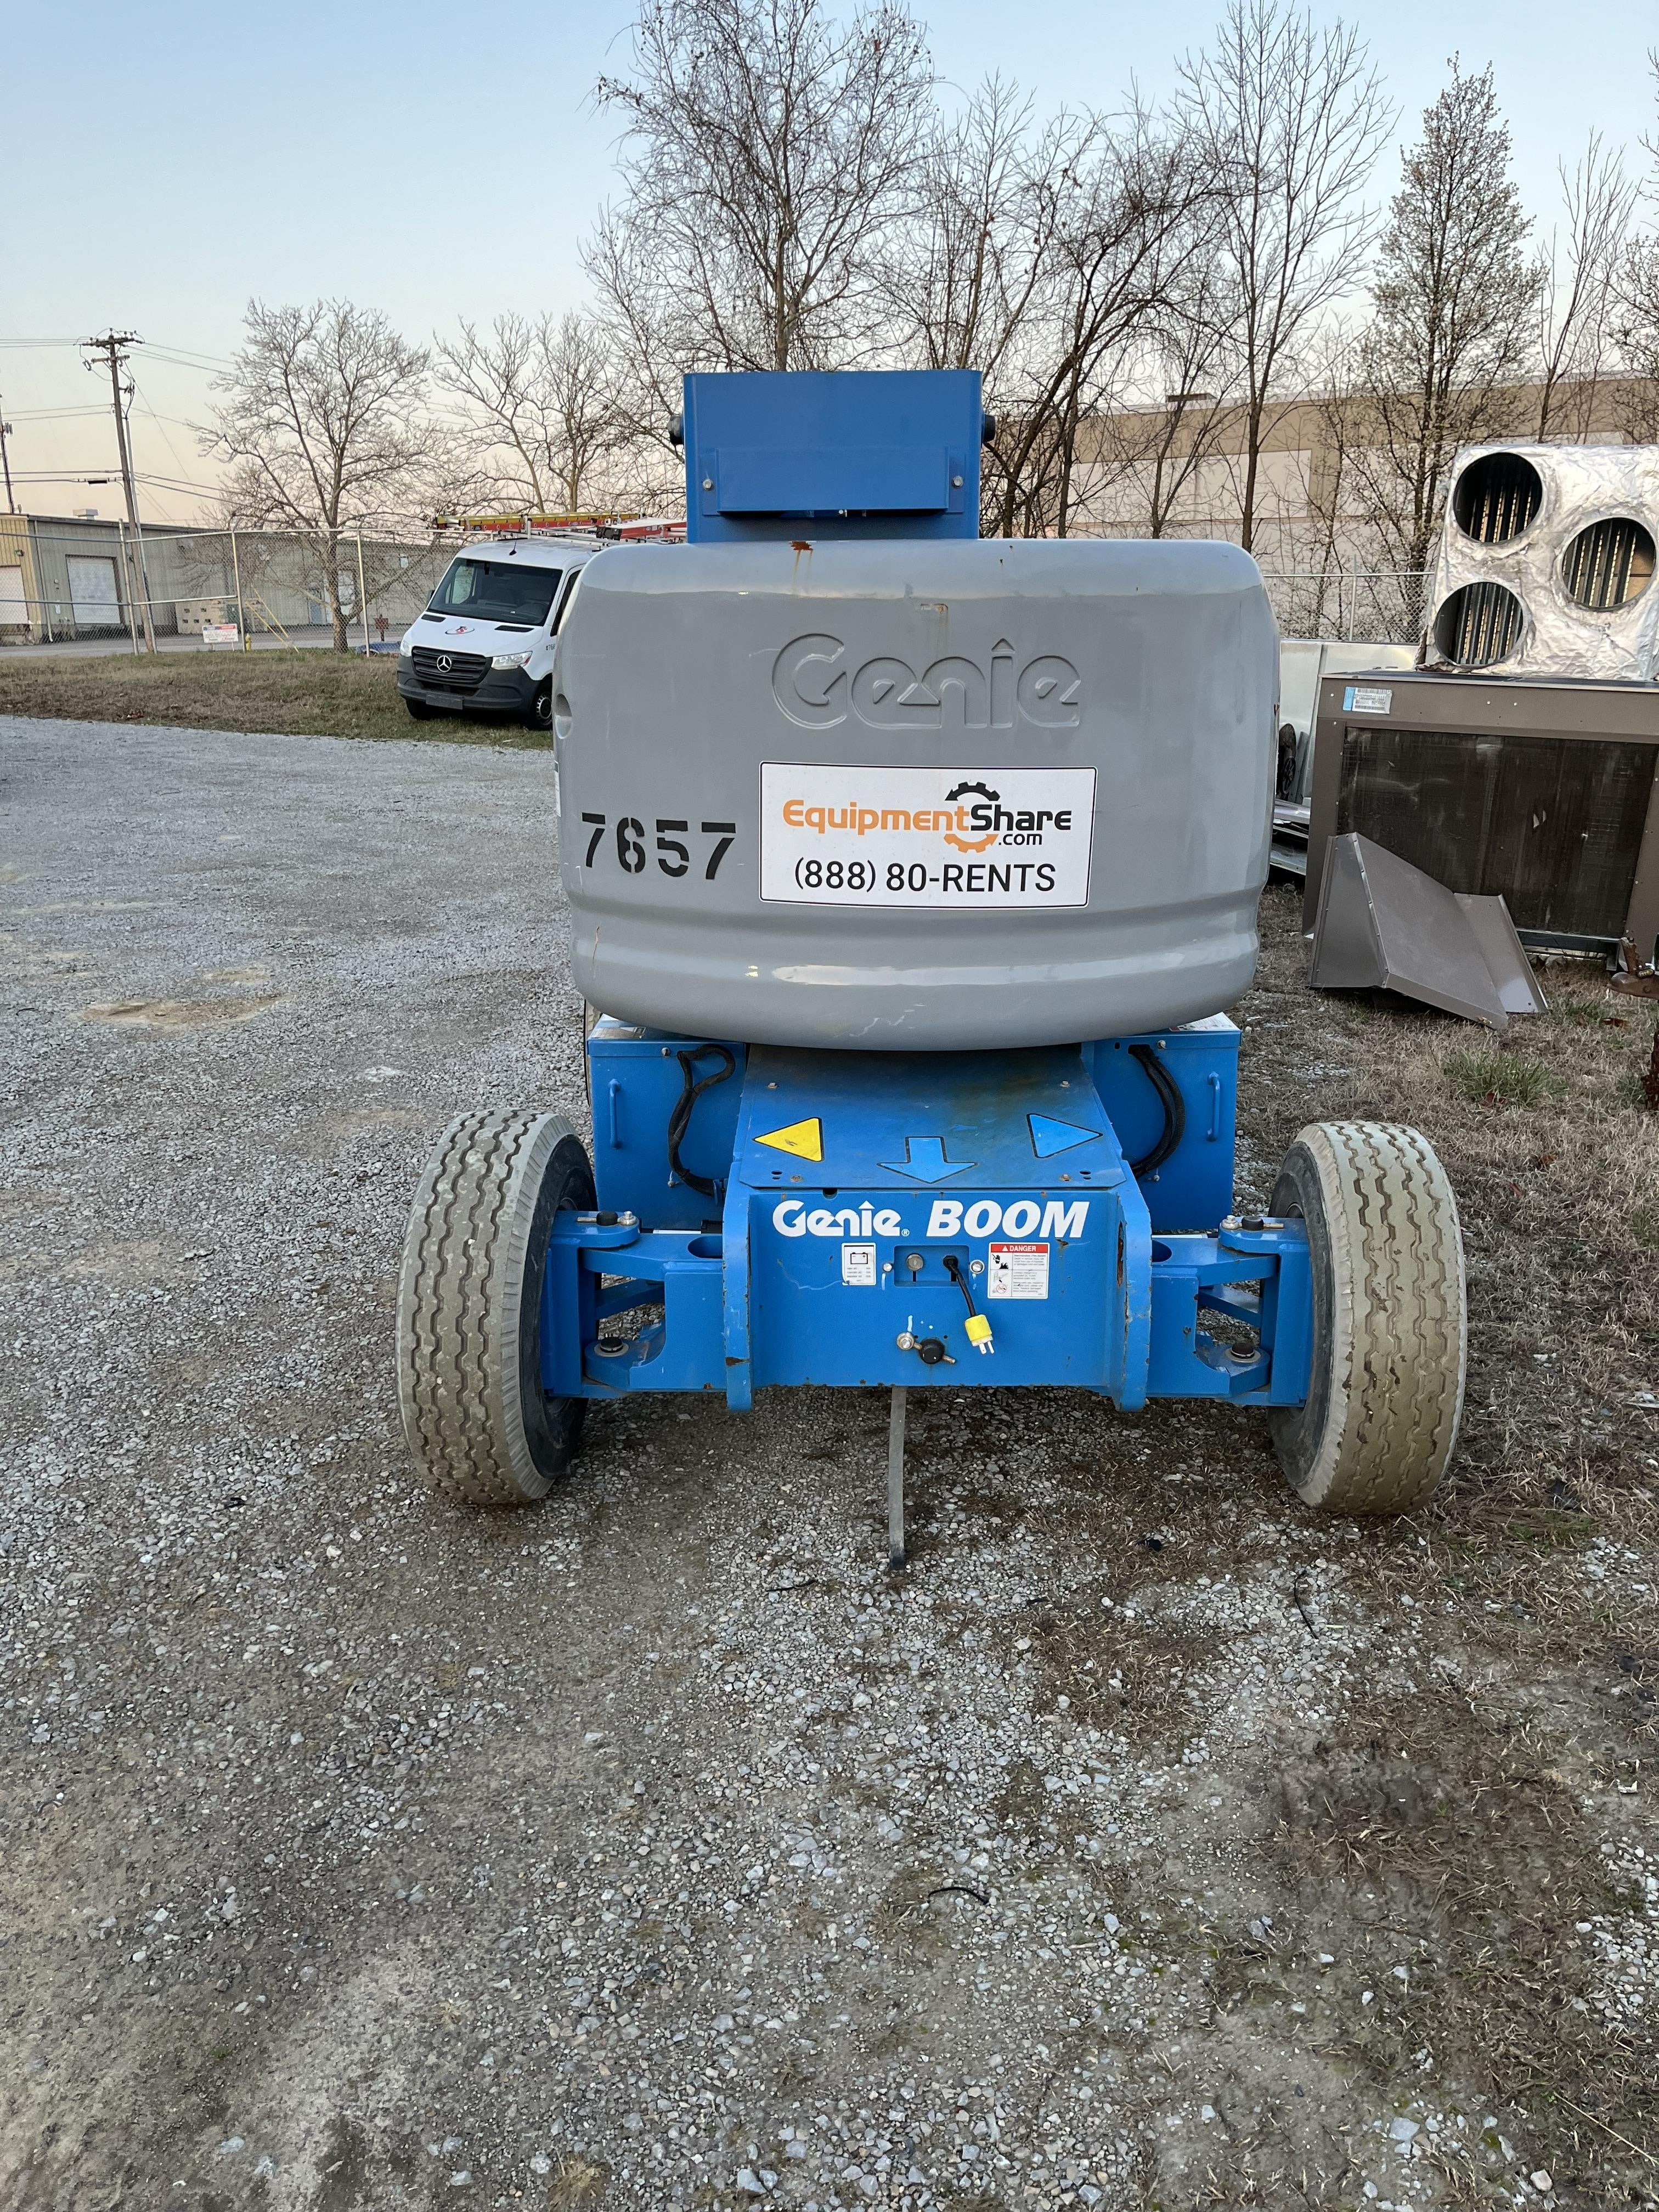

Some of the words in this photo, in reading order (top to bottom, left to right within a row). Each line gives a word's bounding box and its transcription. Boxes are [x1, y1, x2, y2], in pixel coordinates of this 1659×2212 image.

[772, 633, 1081, 730] Genie
[783, 799, 1072, 835] EquipmentShare
[582, 812, 737, 880] 7657
[998, 833, 1042, 846] .com
[795, 857, 876, 893] (888)
[885, 862, 1056, 893] 80-RENTS
[926, 1199, 1090, 1238] BOOM
